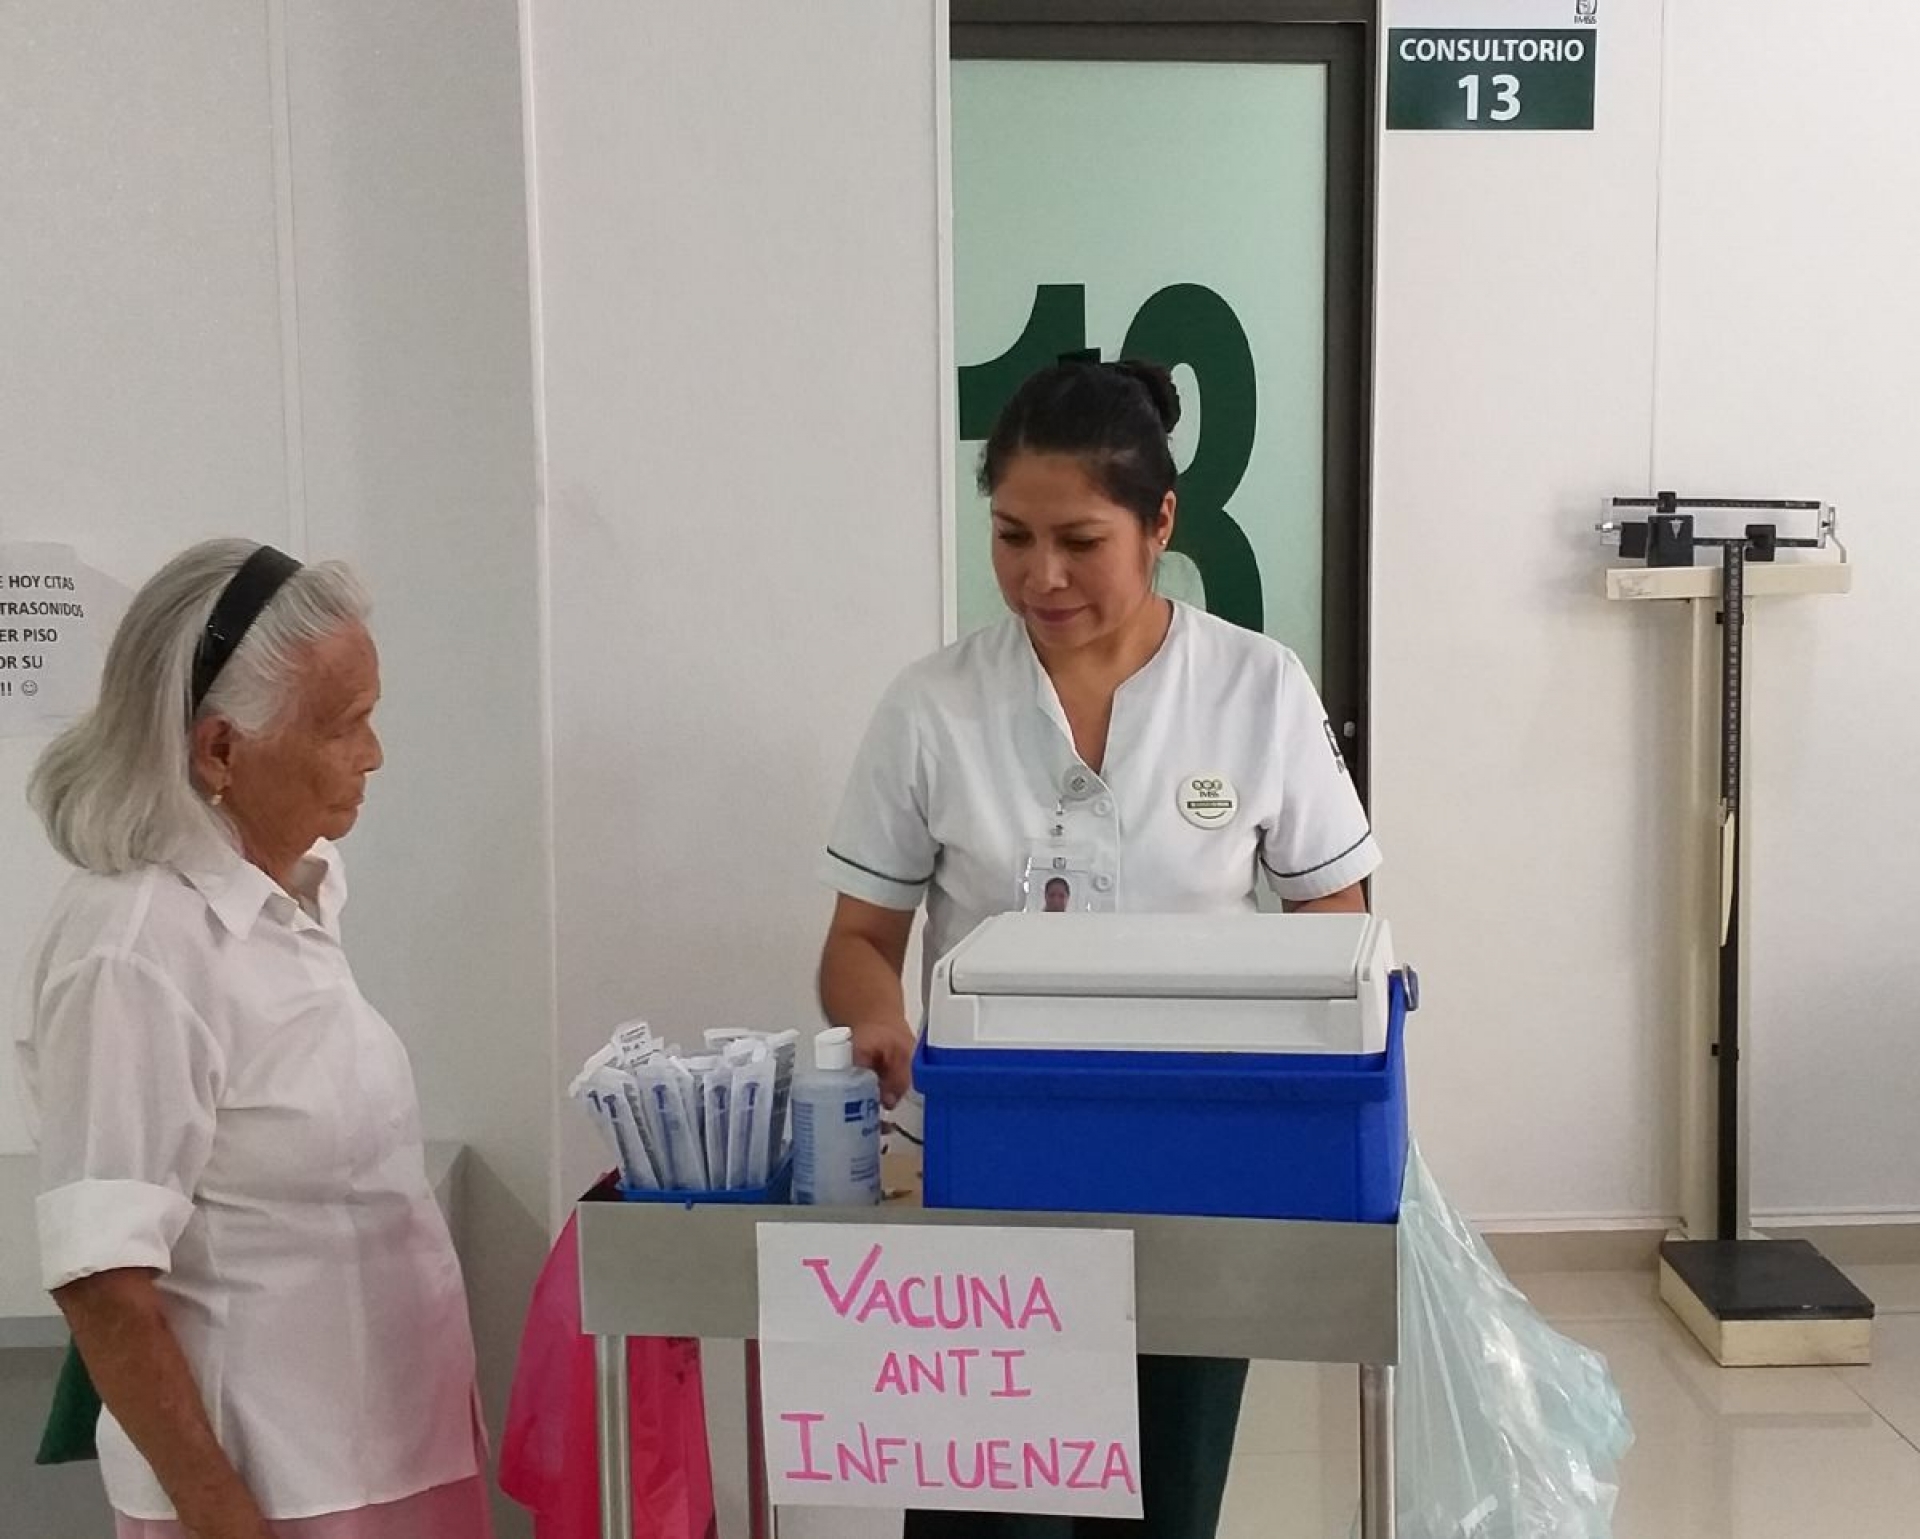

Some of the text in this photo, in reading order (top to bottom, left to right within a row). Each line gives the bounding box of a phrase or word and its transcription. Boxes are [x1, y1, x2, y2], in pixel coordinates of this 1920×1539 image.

[1399, 38, 1585, 62] CONSULTORIO
[1457, 74, 1521, 121] 13
[958, 282, 1264, 635] 3
[9, 575, 41, 588] HOY
[45, 575, 75, 590] CITAS
[0, 628, 58, 643] ER PISO
[22, 655, 43, 670] SU
[802, 1242, 1063, 1332] VACUNA
[874, 1349, 1032, 1398] ANTI
[780, 1412, 1138, 1495] INFLUENZA
